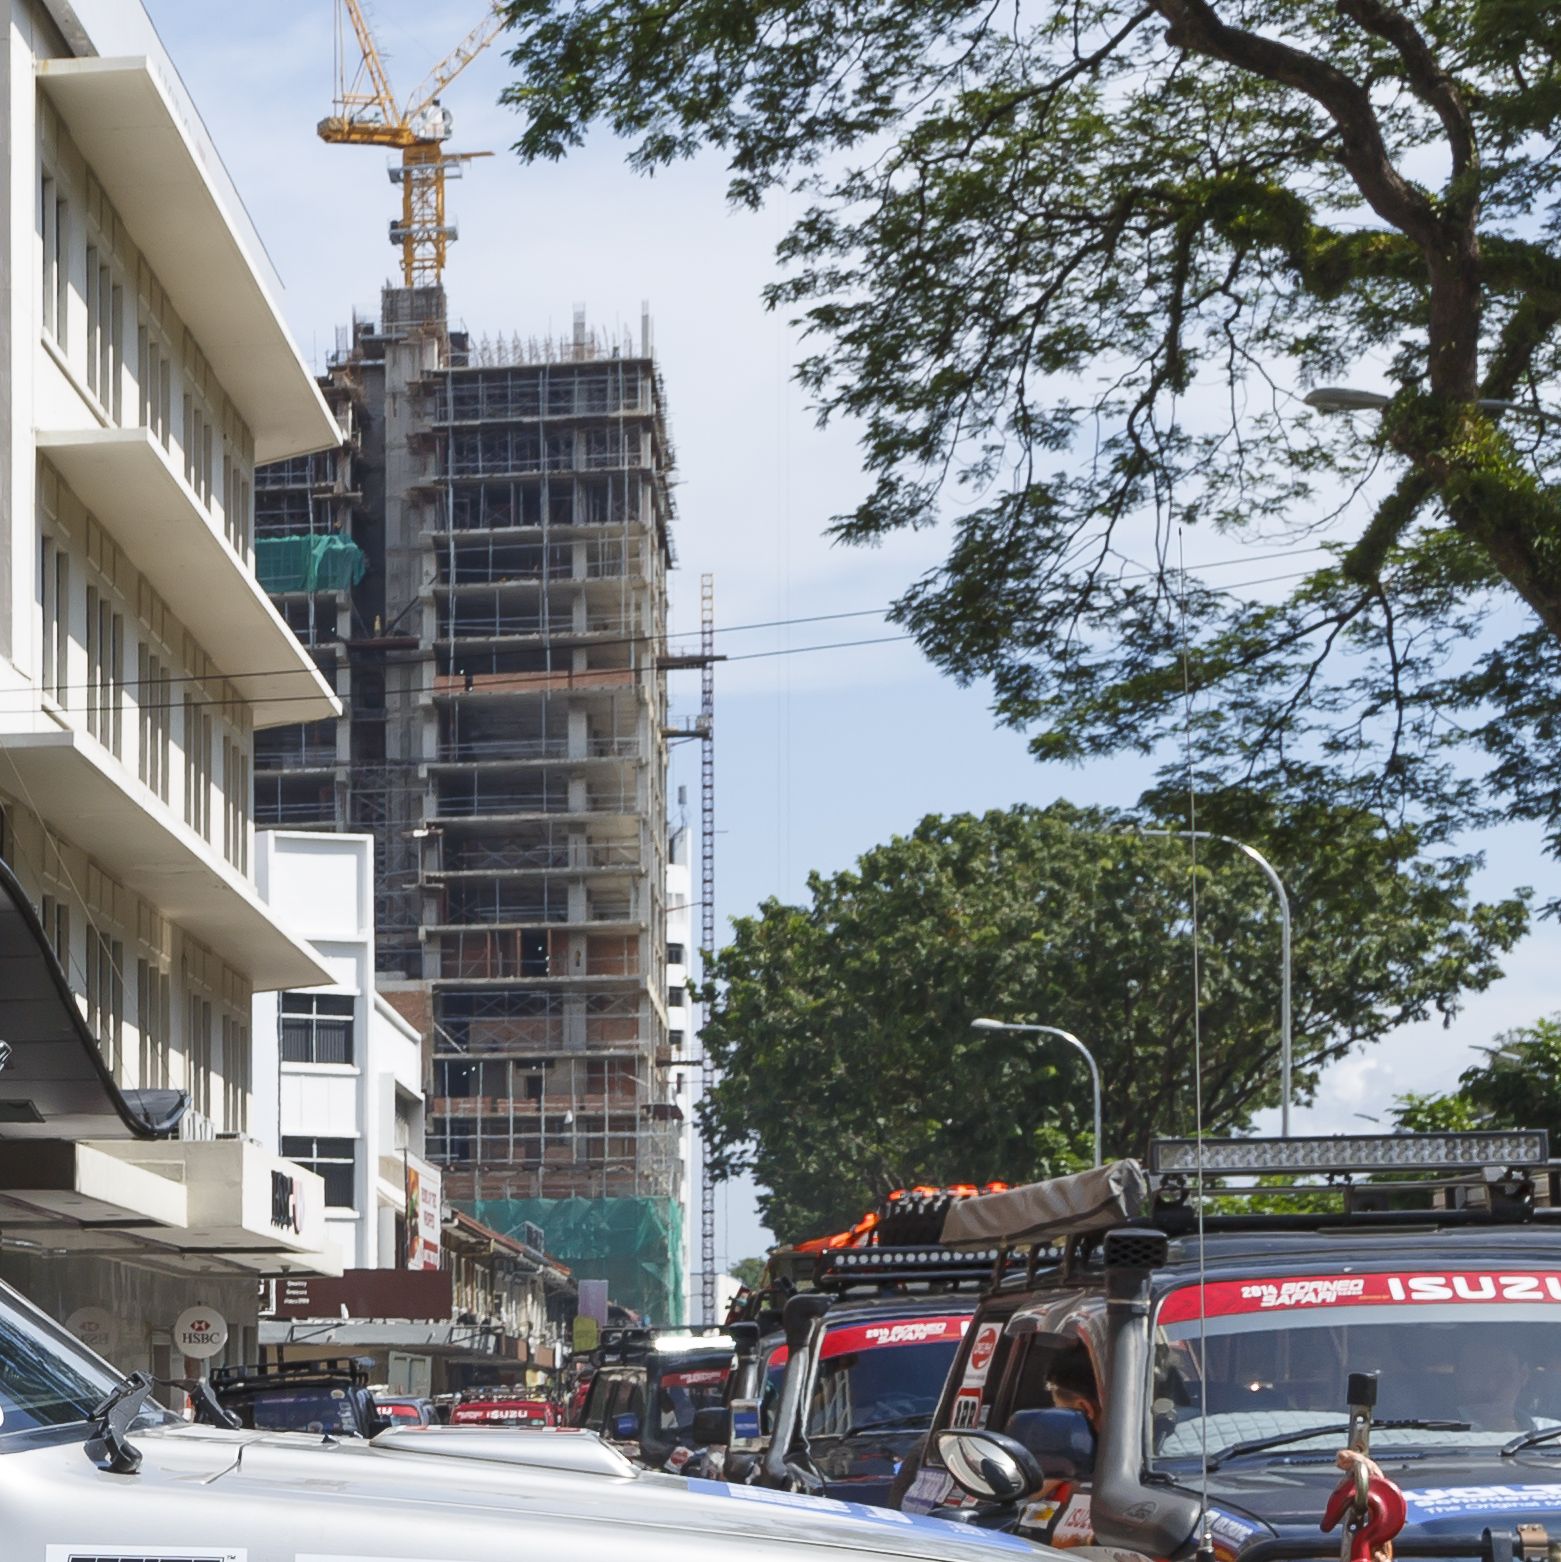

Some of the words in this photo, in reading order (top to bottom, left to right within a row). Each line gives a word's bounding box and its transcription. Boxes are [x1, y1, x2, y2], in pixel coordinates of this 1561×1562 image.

[1241, 1284, 1278, 1299] 2014
[1279, 1278, 1364, 1295] BORNEO
[1260, 1291, 1337, 1308] SAFARI
[182, 1332, 220, 1345] HSBC
